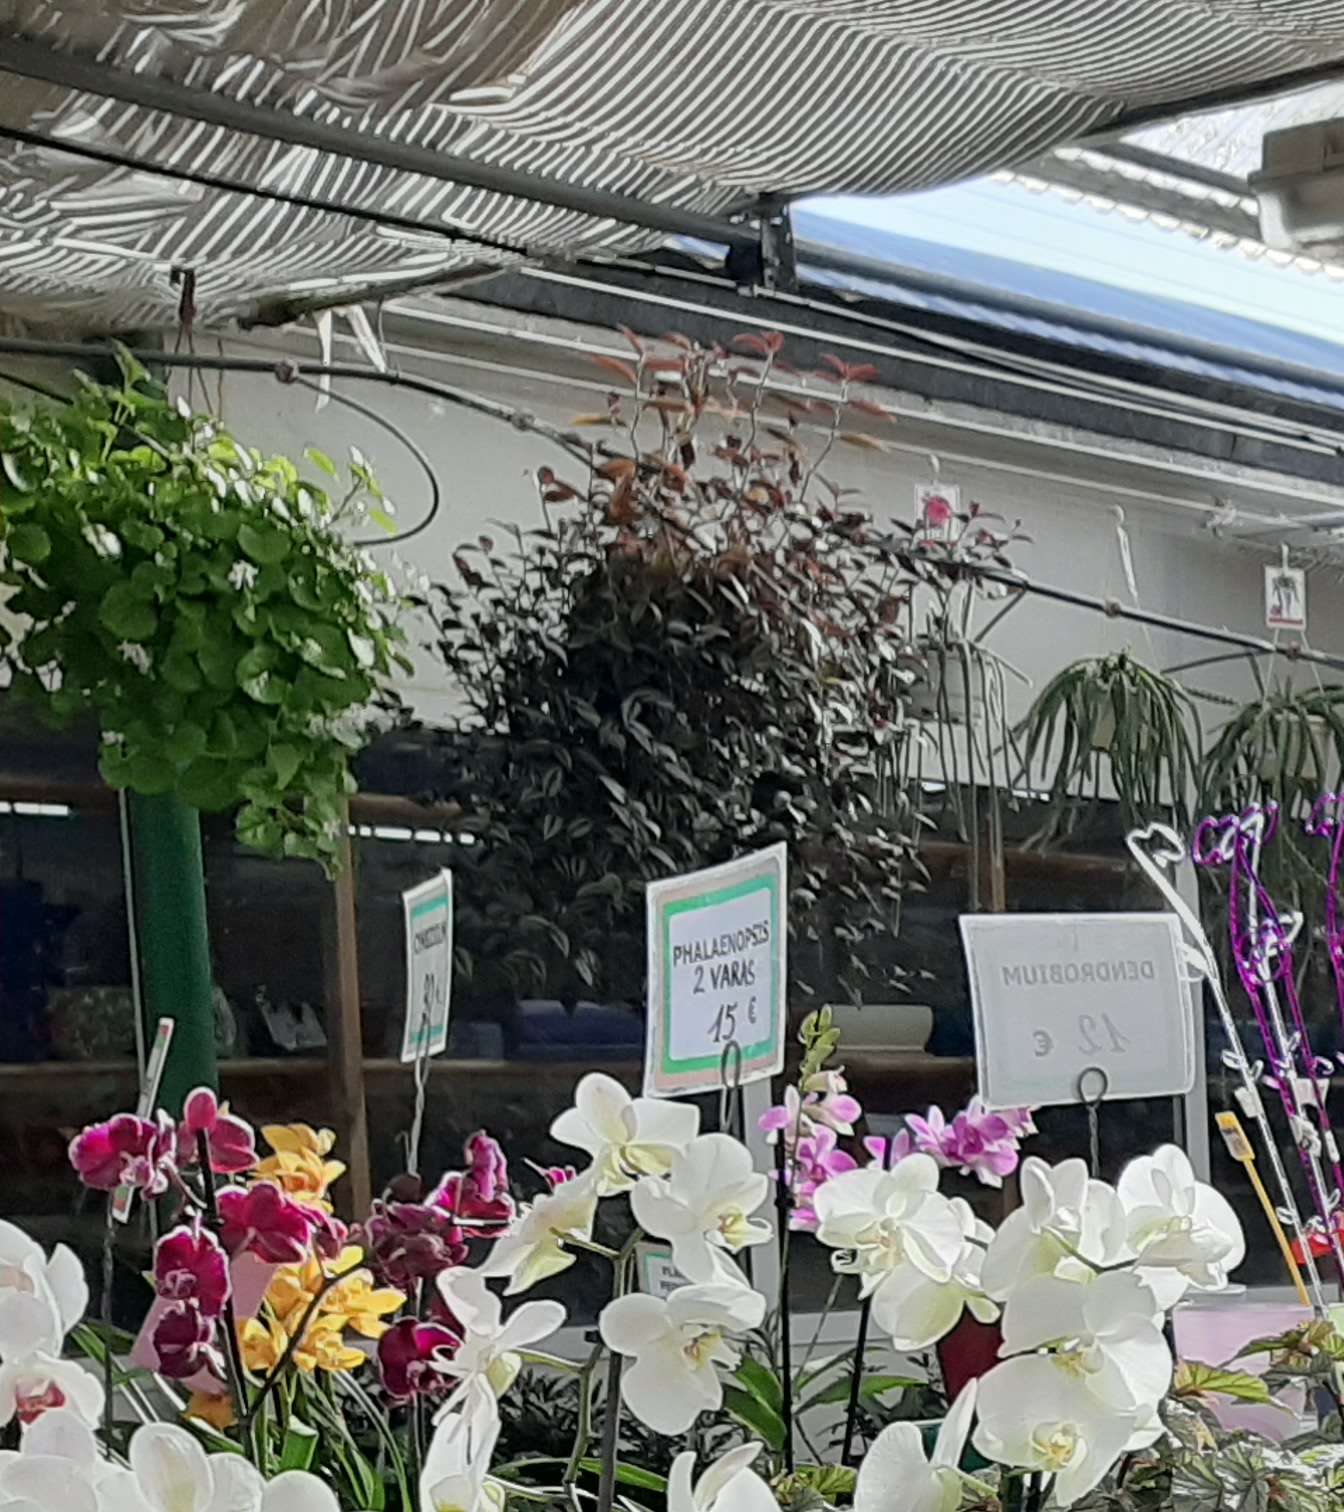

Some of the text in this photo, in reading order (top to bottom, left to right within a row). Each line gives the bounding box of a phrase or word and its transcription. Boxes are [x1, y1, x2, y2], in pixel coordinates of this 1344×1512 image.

[672, 920, 770, 967] PHALAENOPSIS
[693, 959, 756, 994] 2 VARAS
[707, 996, 757, 1043] 15 €
